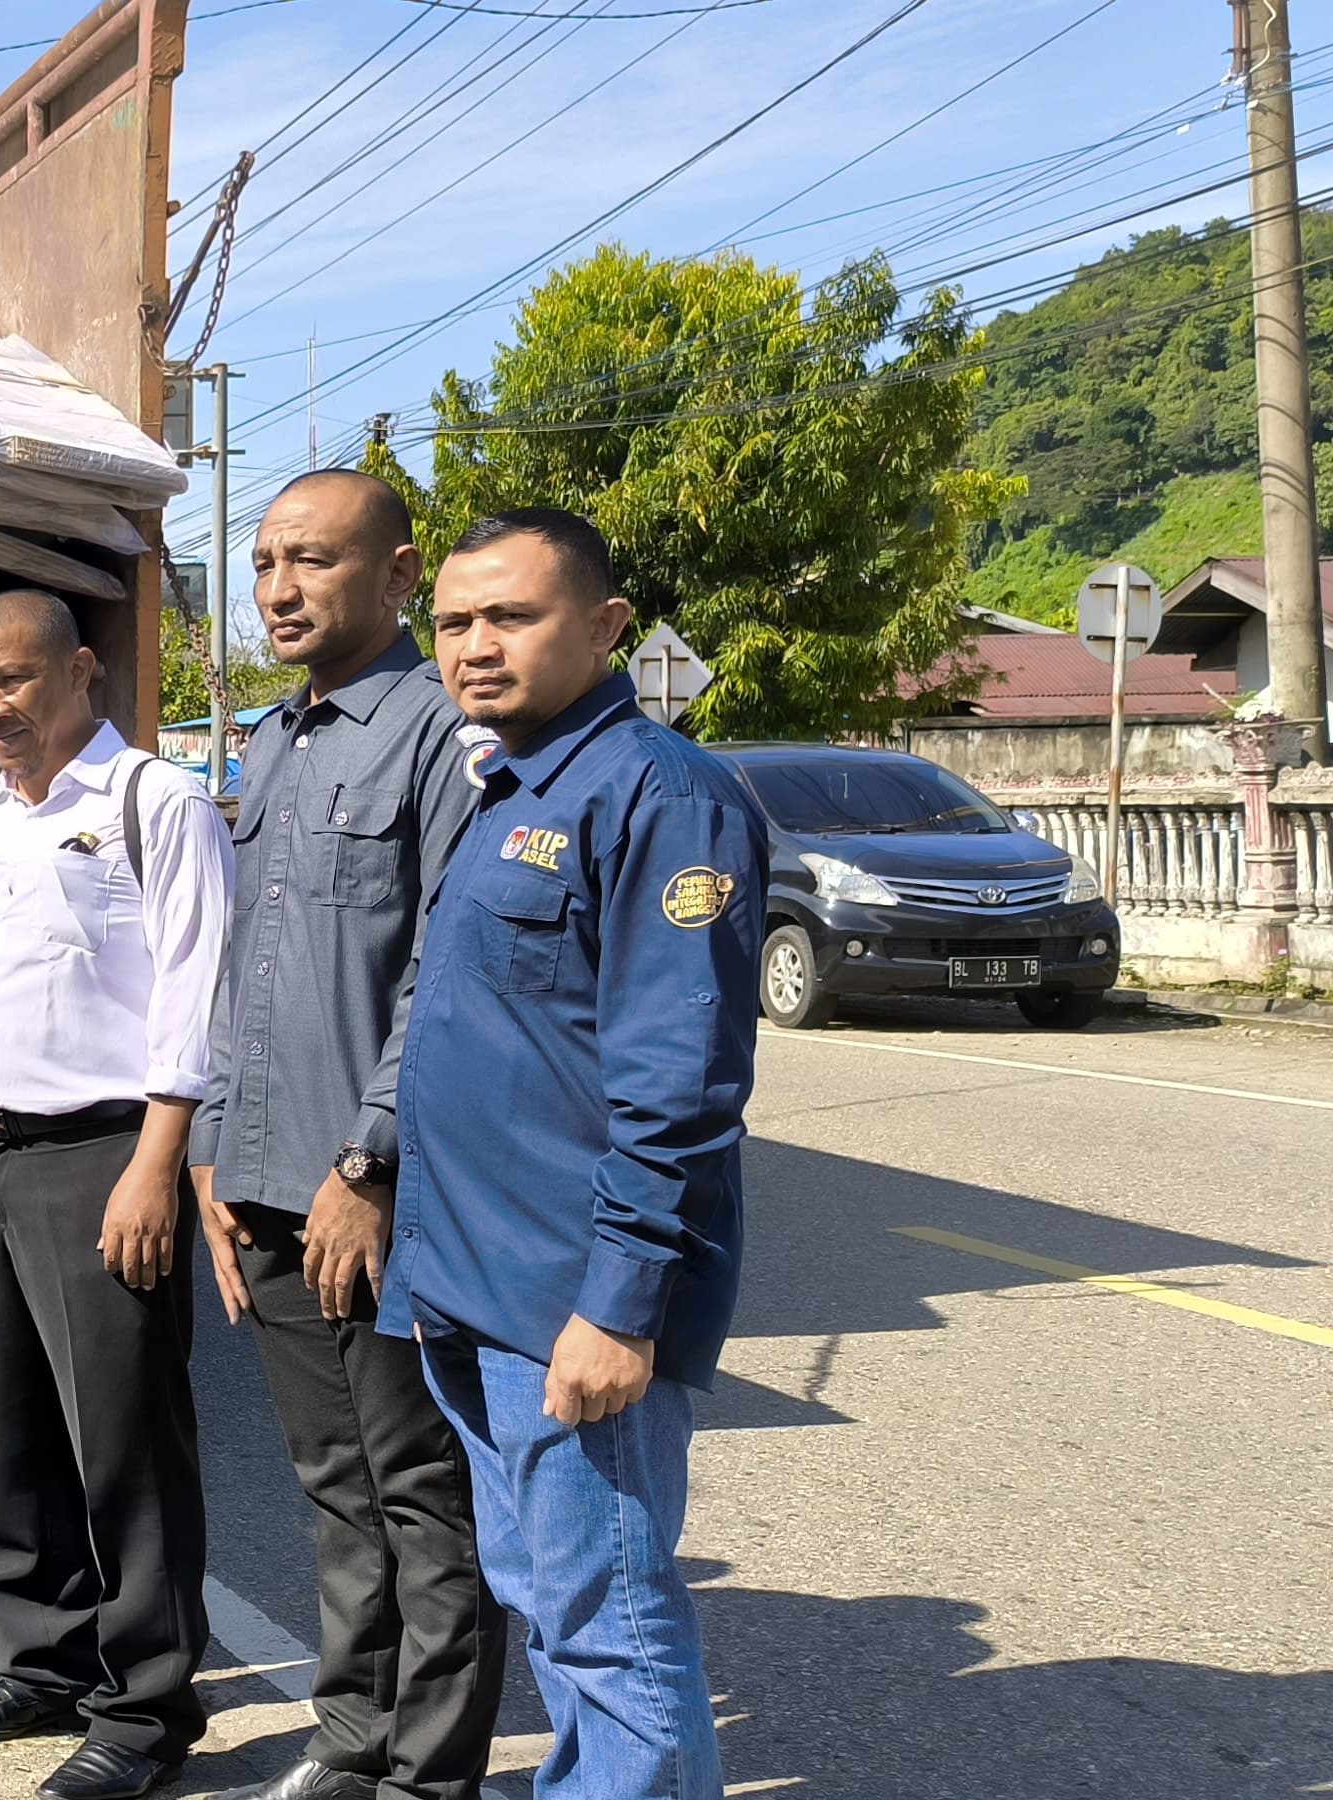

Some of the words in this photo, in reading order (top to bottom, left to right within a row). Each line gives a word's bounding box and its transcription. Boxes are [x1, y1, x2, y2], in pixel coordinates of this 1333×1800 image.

[526, 829, 569, 854] KIP
[518, 848, 559, 870] ASEL
[676, 875, 715, 888] PEMILU
[675, 905, 717, 919] BANGSA
[954, 961, 968, 976] BL
[986, 960, 1007, 976] 133
[1022, 960, 1038, 975] TB
